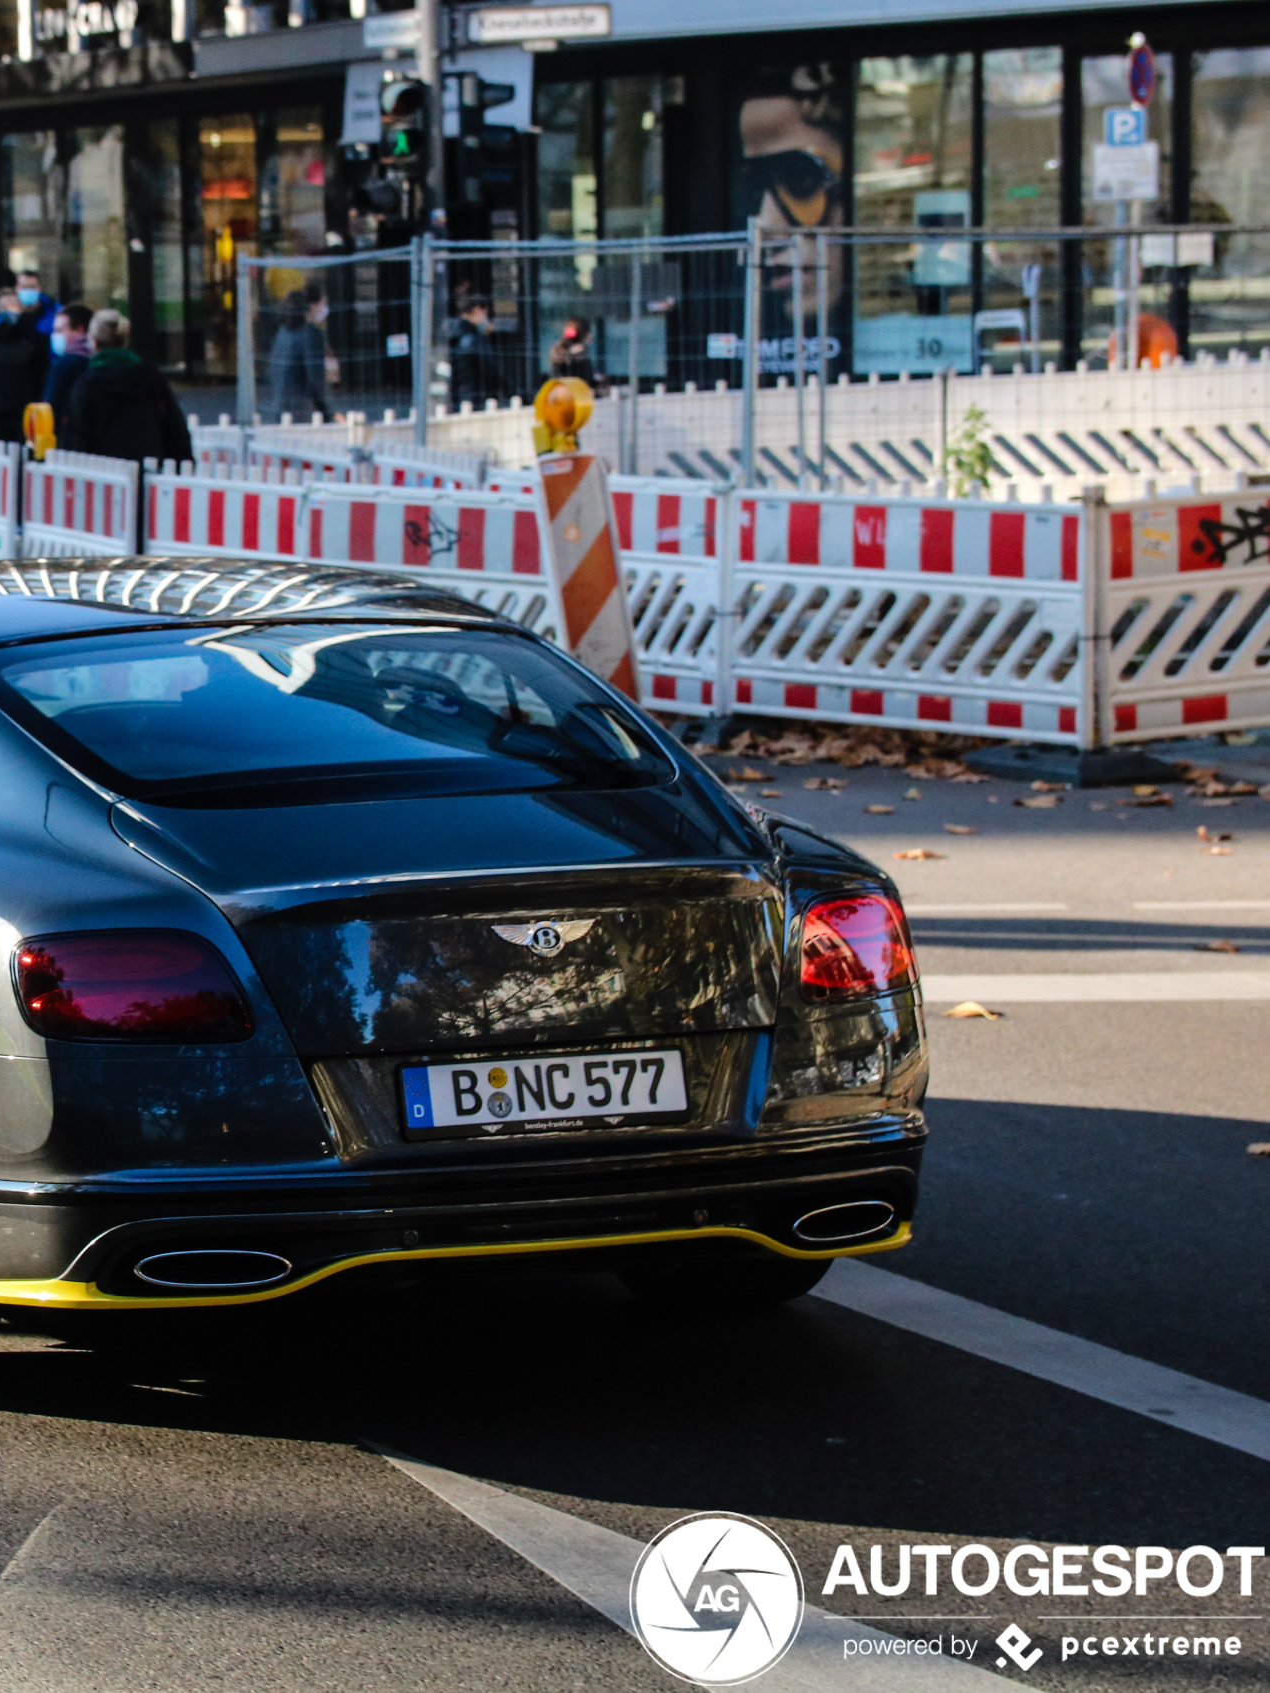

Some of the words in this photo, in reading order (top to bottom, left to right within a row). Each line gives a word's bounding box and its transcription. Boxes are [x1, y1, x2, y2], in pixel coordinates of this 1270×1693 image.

[451, 1069, 483, 1117] B
[514, 1063, 575, 1112] NC
[584, 1058, 665, 1107] 577
[414, 1104, 425, 1118] D
